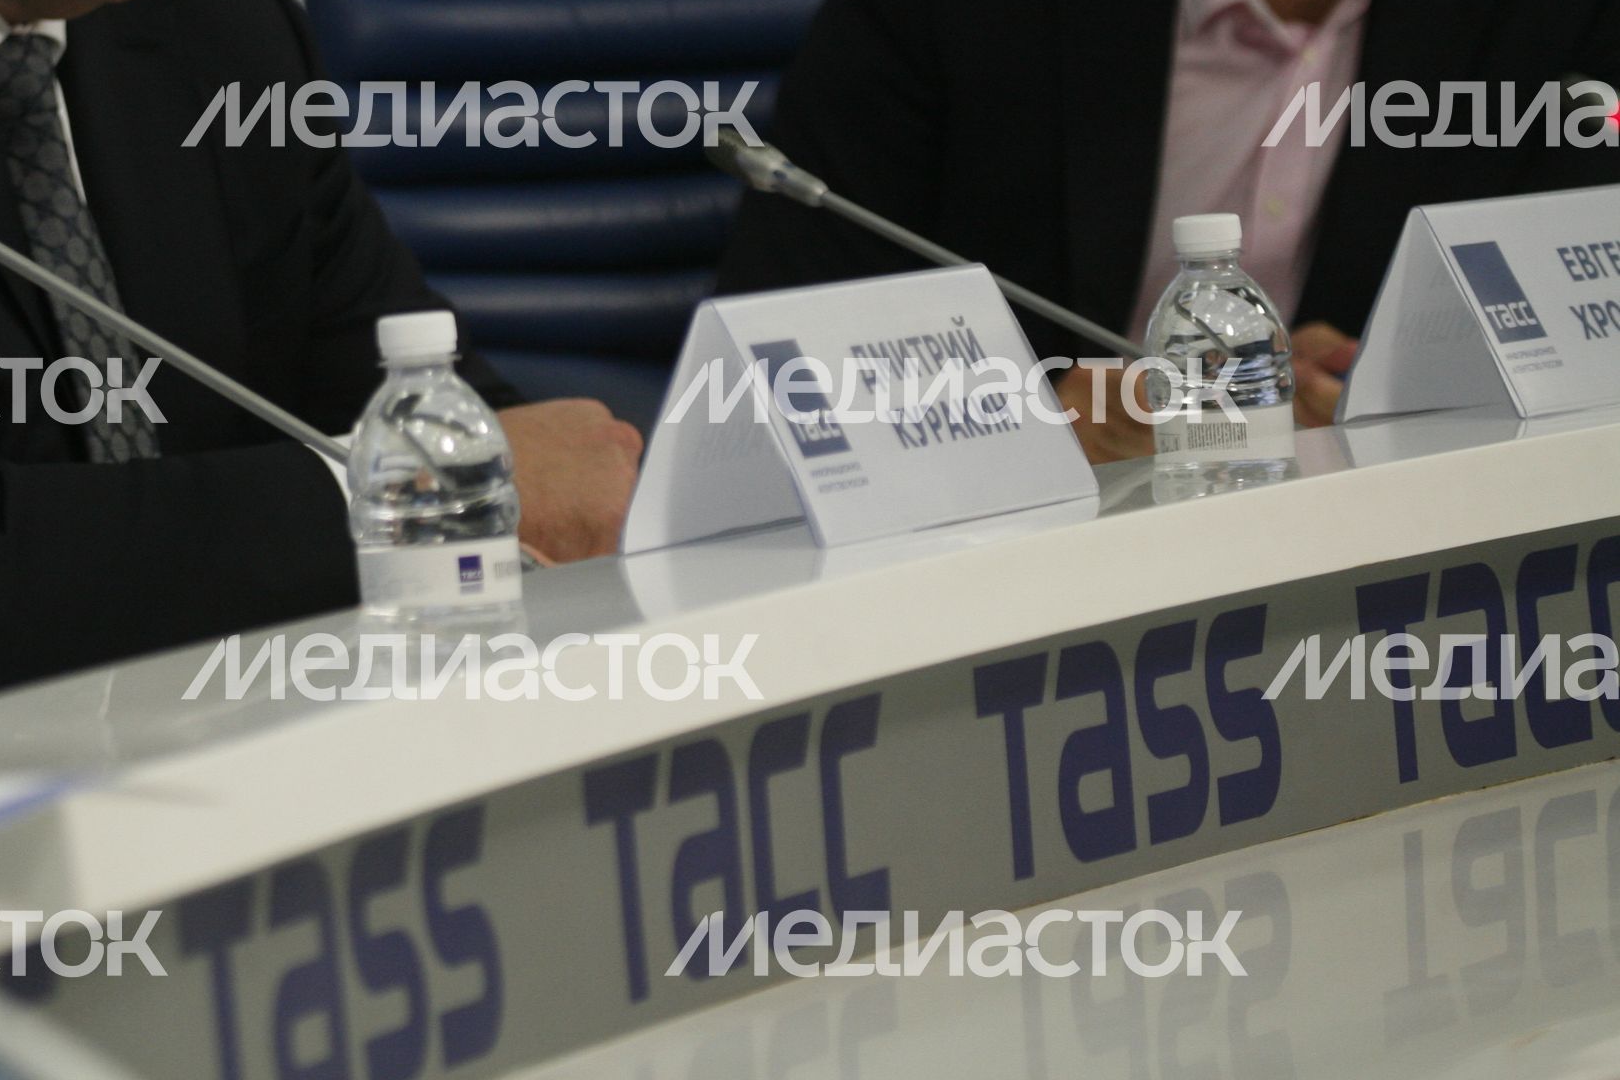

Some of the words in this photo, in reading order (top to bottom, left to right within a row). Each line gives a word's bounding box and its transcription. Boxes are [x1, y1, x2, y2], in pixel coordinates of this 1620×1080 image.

[1557, 240, 1620, 281] ЕВГЕ
[849, 315, 989, 394] ДМИТРИЙ
[886, 392, 1021, 450] КУРАКИН
